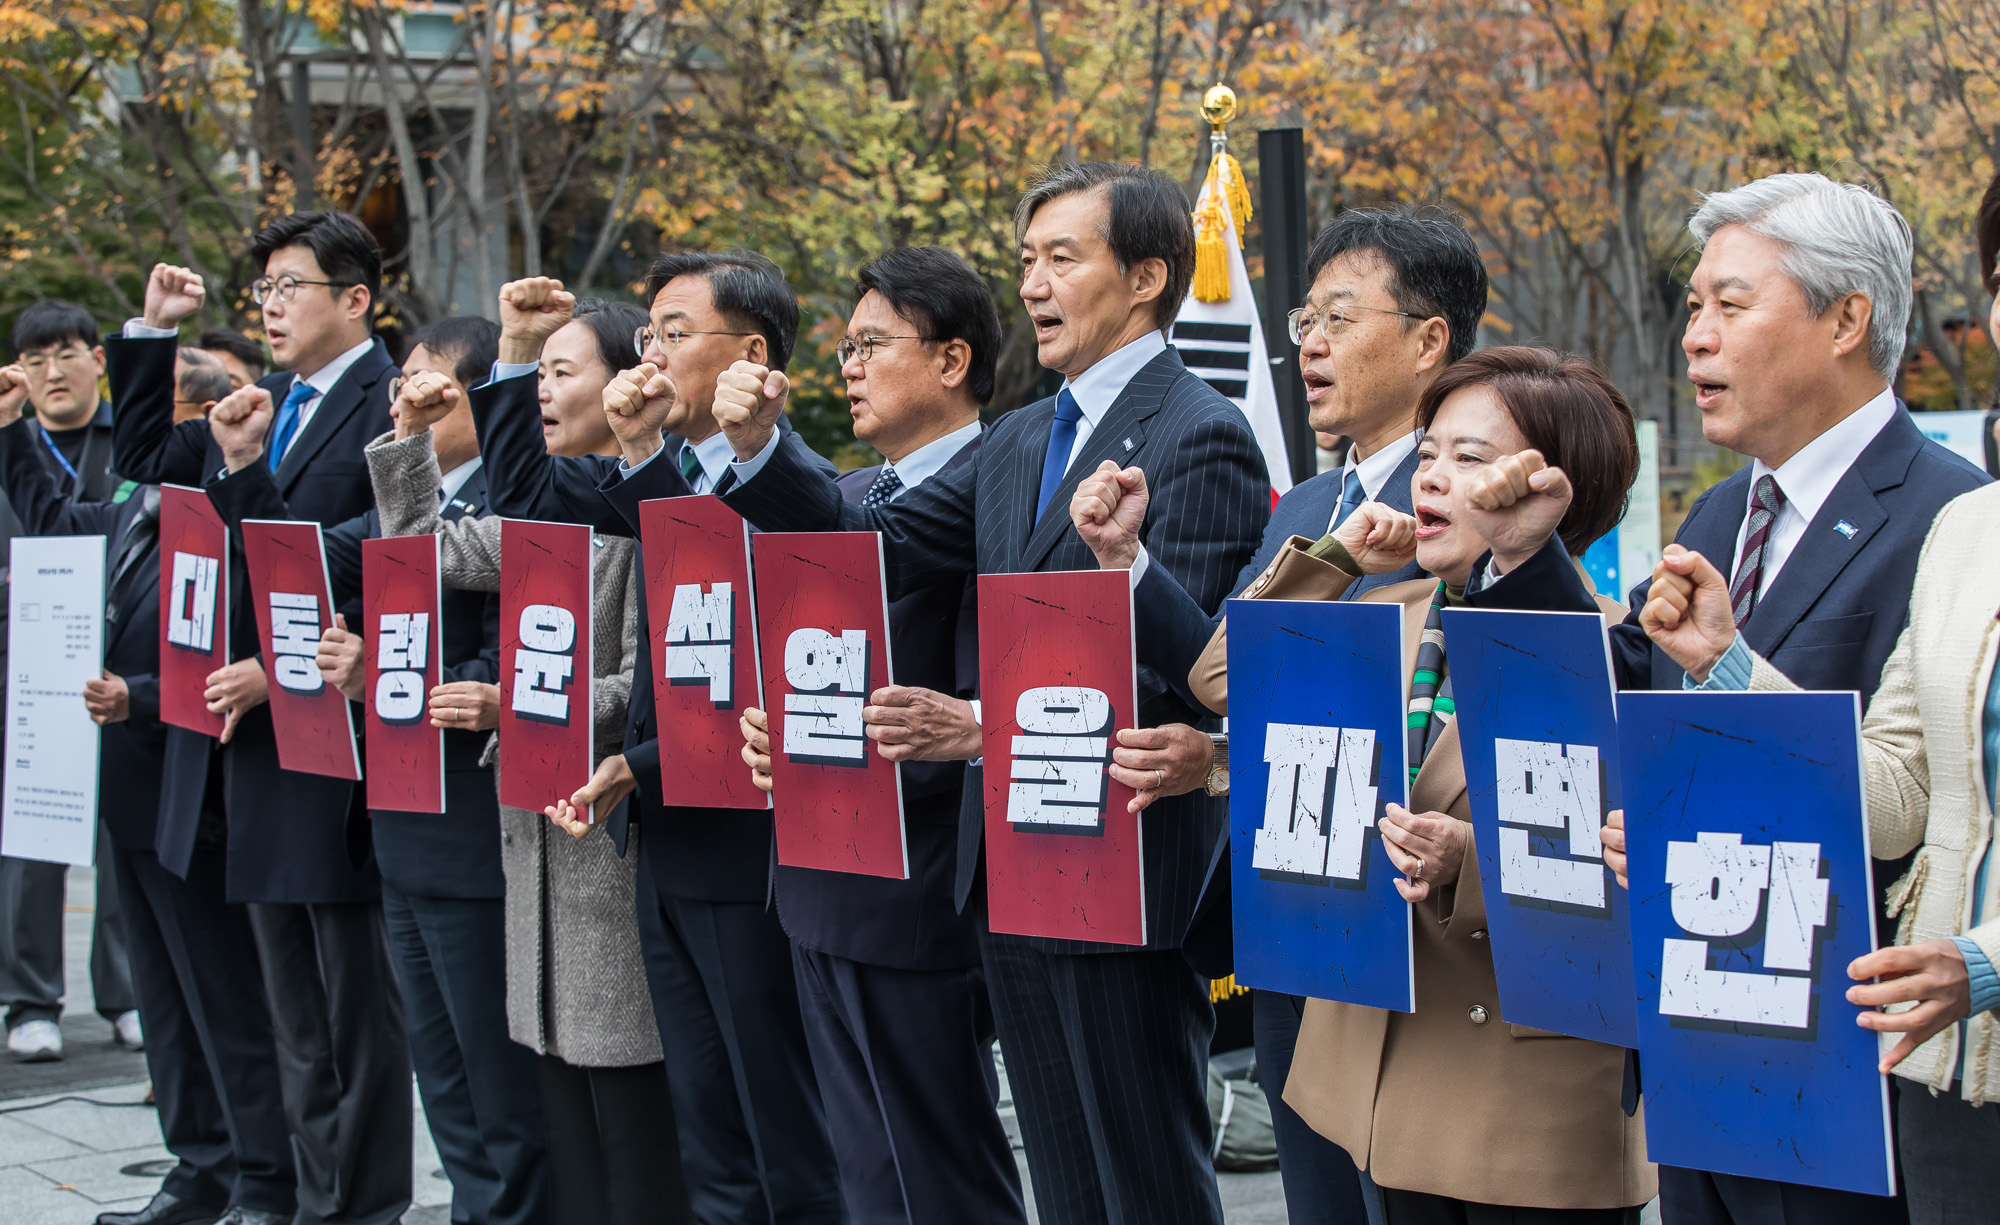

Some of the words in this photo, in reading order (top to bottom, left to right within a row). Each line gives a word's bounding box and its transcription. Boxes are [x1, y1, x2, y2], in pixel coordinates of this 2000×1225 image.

[168, 552, 218, 650] 대
[269, 592, 324, 689] 통
[512, 606, 574, 718] 윤
[665, 582, 731, 701] 석
[376, 613, 428, 718] 령
[783, 628, 867, 758] 열
[1007, 687, 1109, 826] 을
[1252, 723, 1378, 879] 파
[1496, 739, 1606, 908] 면
[1659, 833, 1829, 1028] 한
